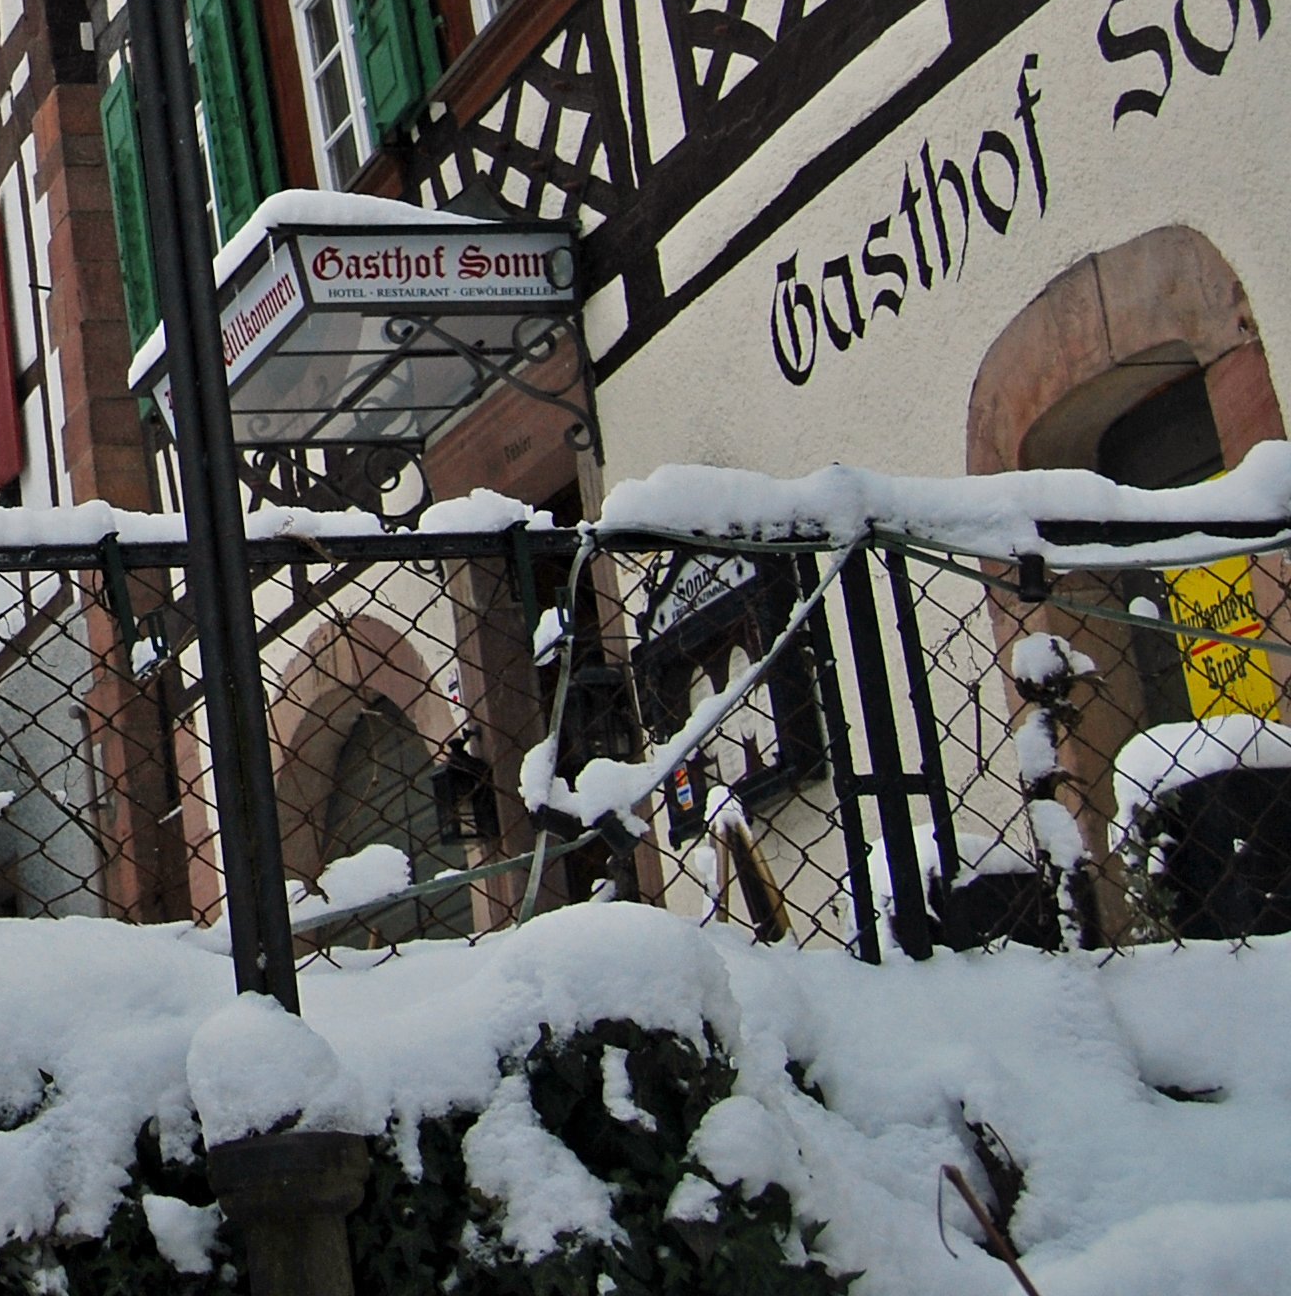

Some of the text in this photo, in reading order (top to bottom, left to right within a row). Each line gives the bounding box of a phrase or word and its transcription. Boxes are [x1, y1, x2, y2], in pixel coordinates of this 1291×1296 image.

[771, 53, 1048, 386] Gasthof
[312, 245, 547, 285] Gasthof Sonn
[328, 285, 559, 298] HOTEL RESTAURANT GEWÖLBEKELLER
[673, 561, 719, 607] Sonn
